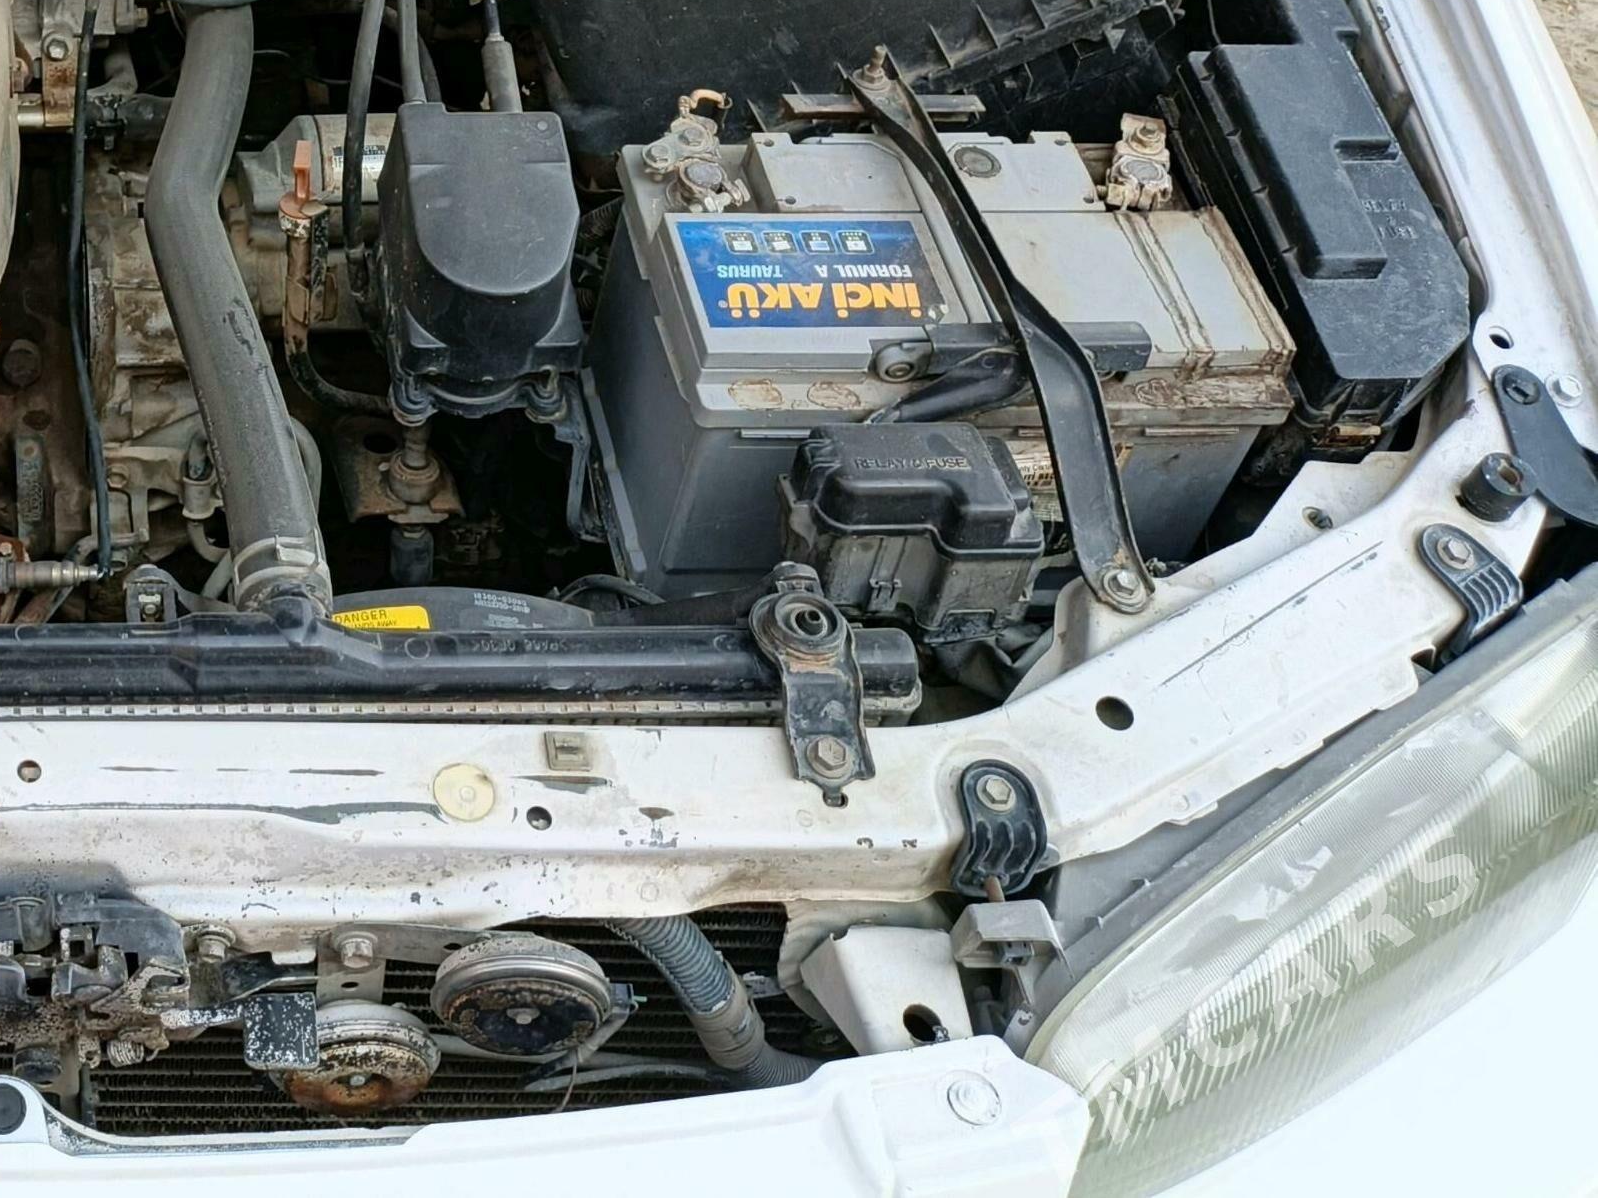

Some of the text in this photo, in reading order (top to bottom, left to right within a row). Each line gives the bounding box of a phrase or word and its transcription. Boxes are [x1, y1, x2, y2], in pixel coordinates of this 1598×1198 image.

[716, 264, 913, 279] FORMUL A TAURUS
[854, 456, 907, 470] RELAY
[926, 456, 970, 470] FUSE
[334, 609, 388, 624] DANGER
